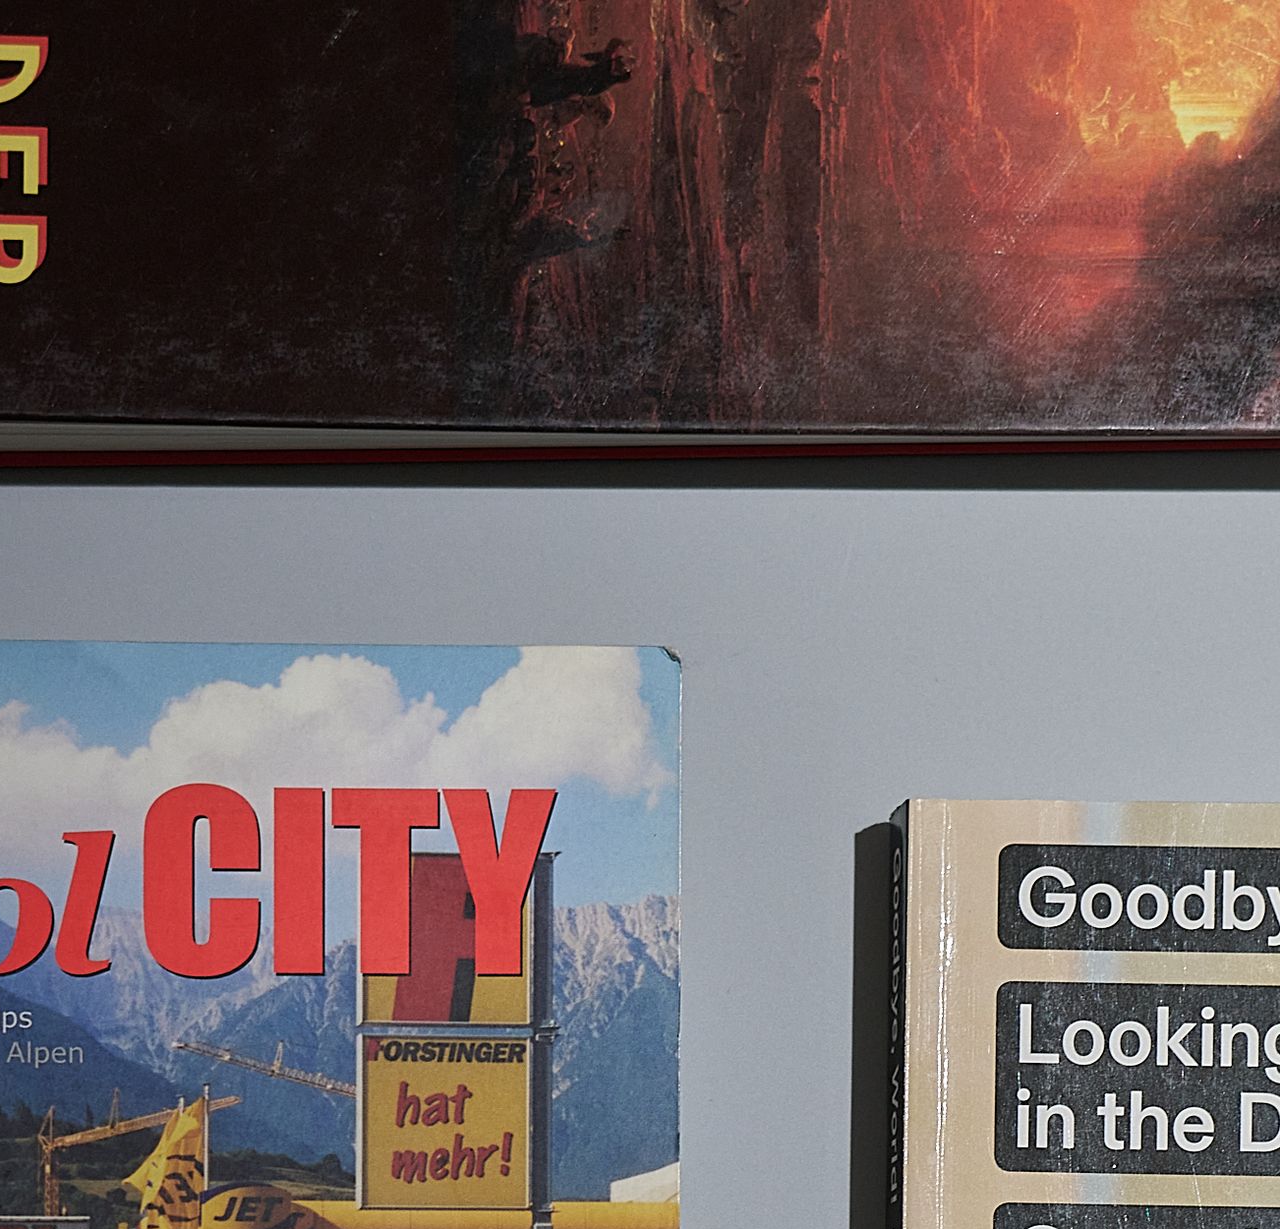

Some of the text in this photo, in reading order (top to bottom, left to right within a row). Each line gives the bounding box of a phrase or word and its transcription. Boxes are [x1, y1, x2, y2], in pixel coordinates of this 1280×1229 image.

[143, 782, 559, 980] CITY
[7, 1040, 85, 1069] Alpen
[368, 1039, 527, 1063] FORSTINGER
[395, 1080, 474, 1128] hat
[1015, 1088, 1075, 1150] in
[1096, 1091, 1215, 1153] the
[390, 1131, 515, 1184] mehr!
[213, 1196, 284, 1223] JET
